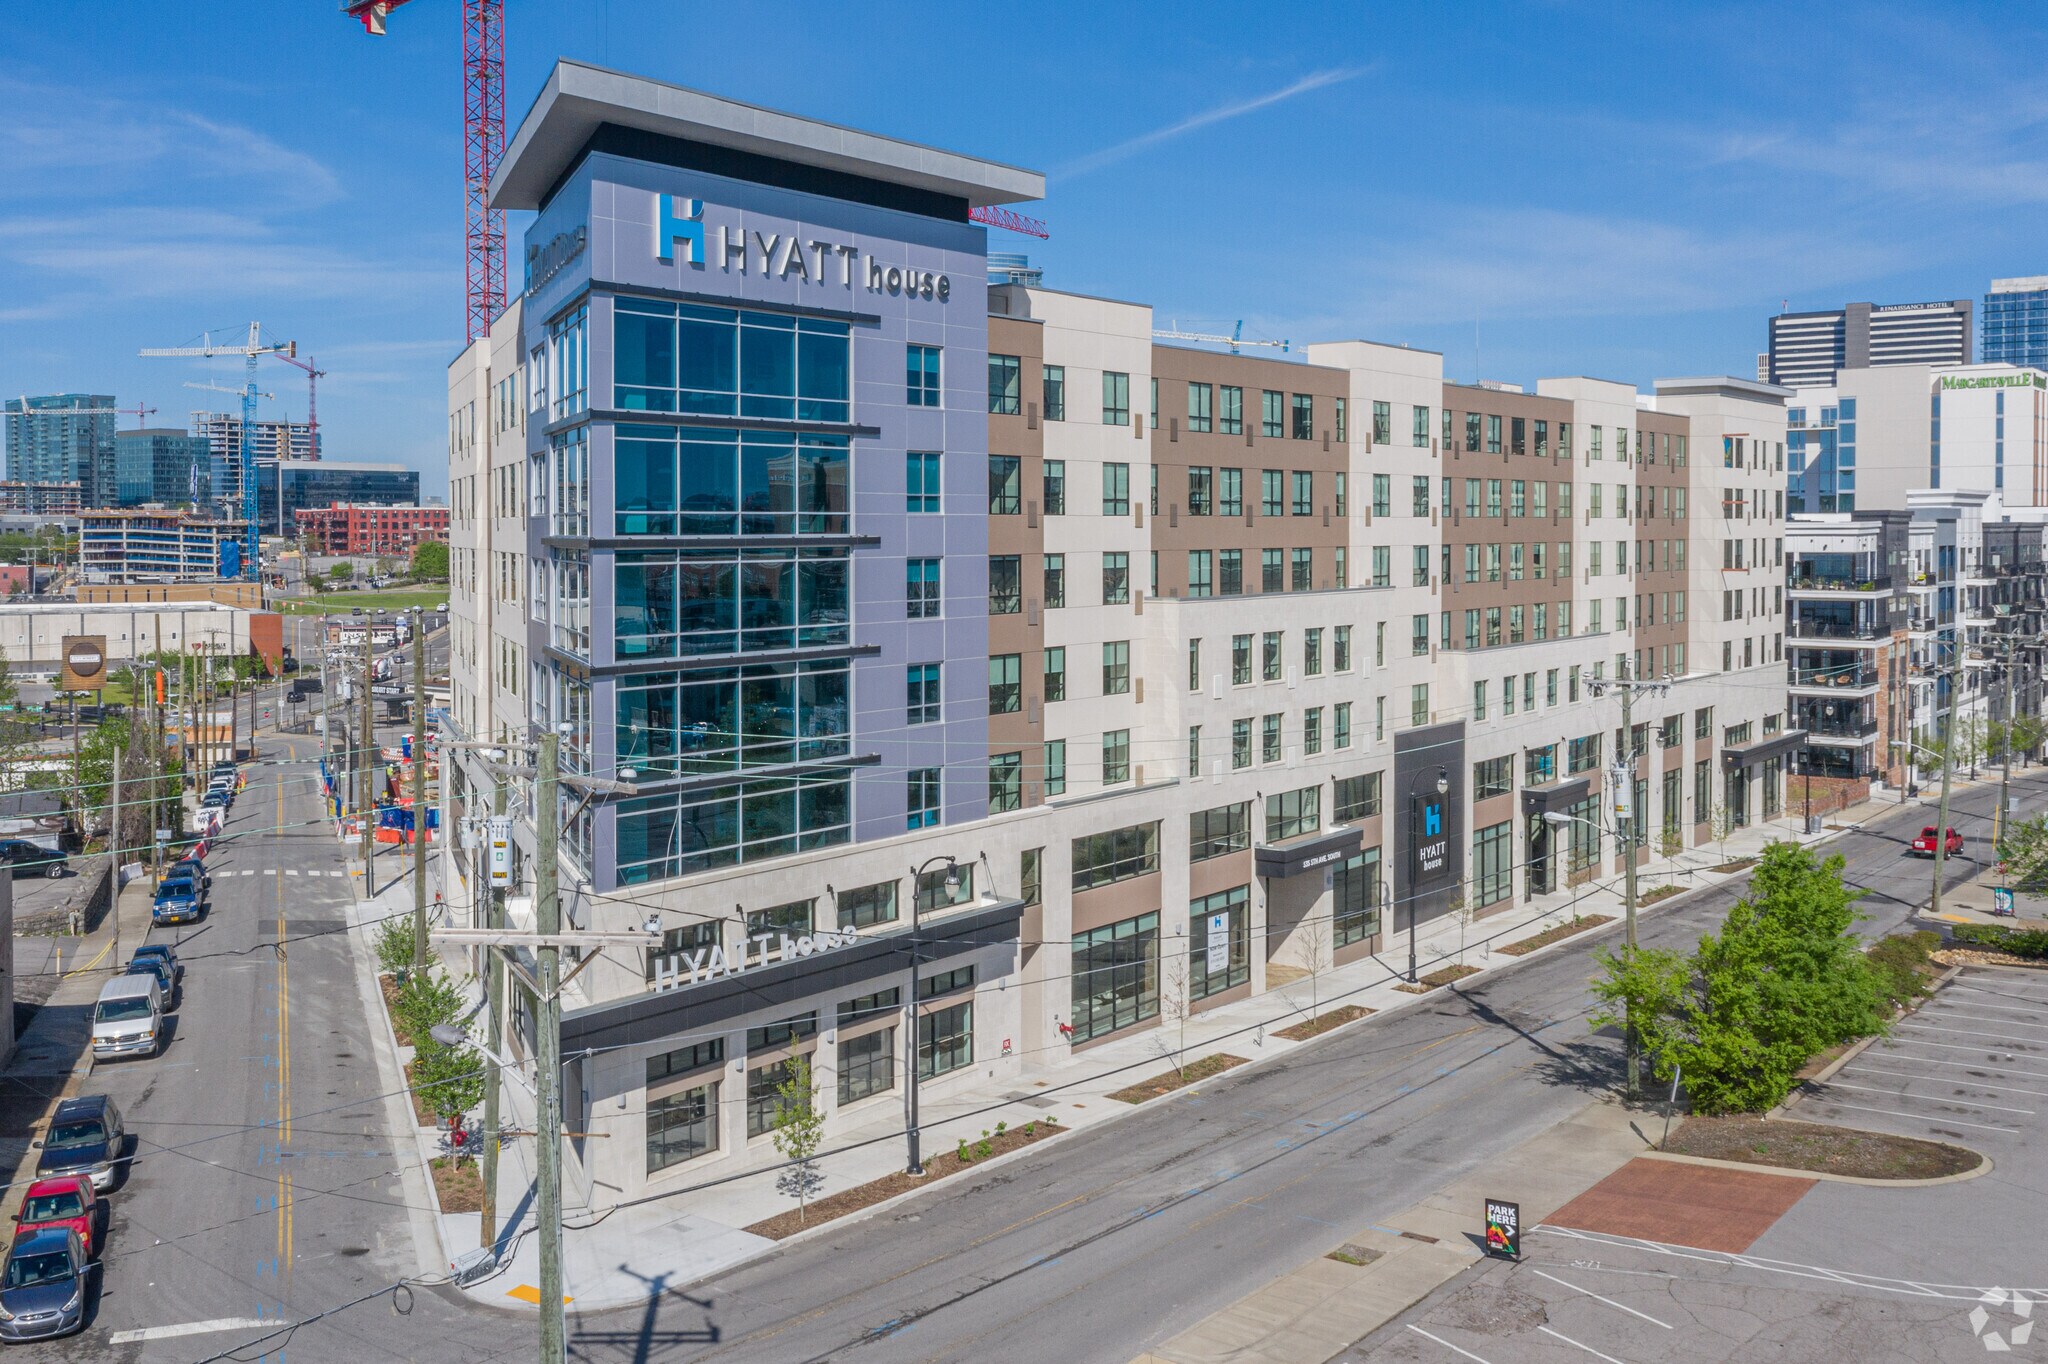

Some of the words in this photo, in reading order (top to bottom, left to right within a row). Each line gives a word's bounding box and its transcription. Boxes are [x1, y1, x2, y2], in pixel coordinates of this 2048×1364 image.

[720, 226, 858, 285] HYATT
[864, 254, 950, 298] house
[1880, 304, 1923, 312] RENAISSANCE
[1327, 850, 1342, 860] SOUTH
[1420, 841, 1446, 861] HYATT
[1424, 858, 1442, 871] house
[655, 932, 774, 993] HYATT
[779, 924, 857, 961] house
[1488, 1204, 1515, 1217] PARK
[1487, 1212, 1517, 1226] HERE
